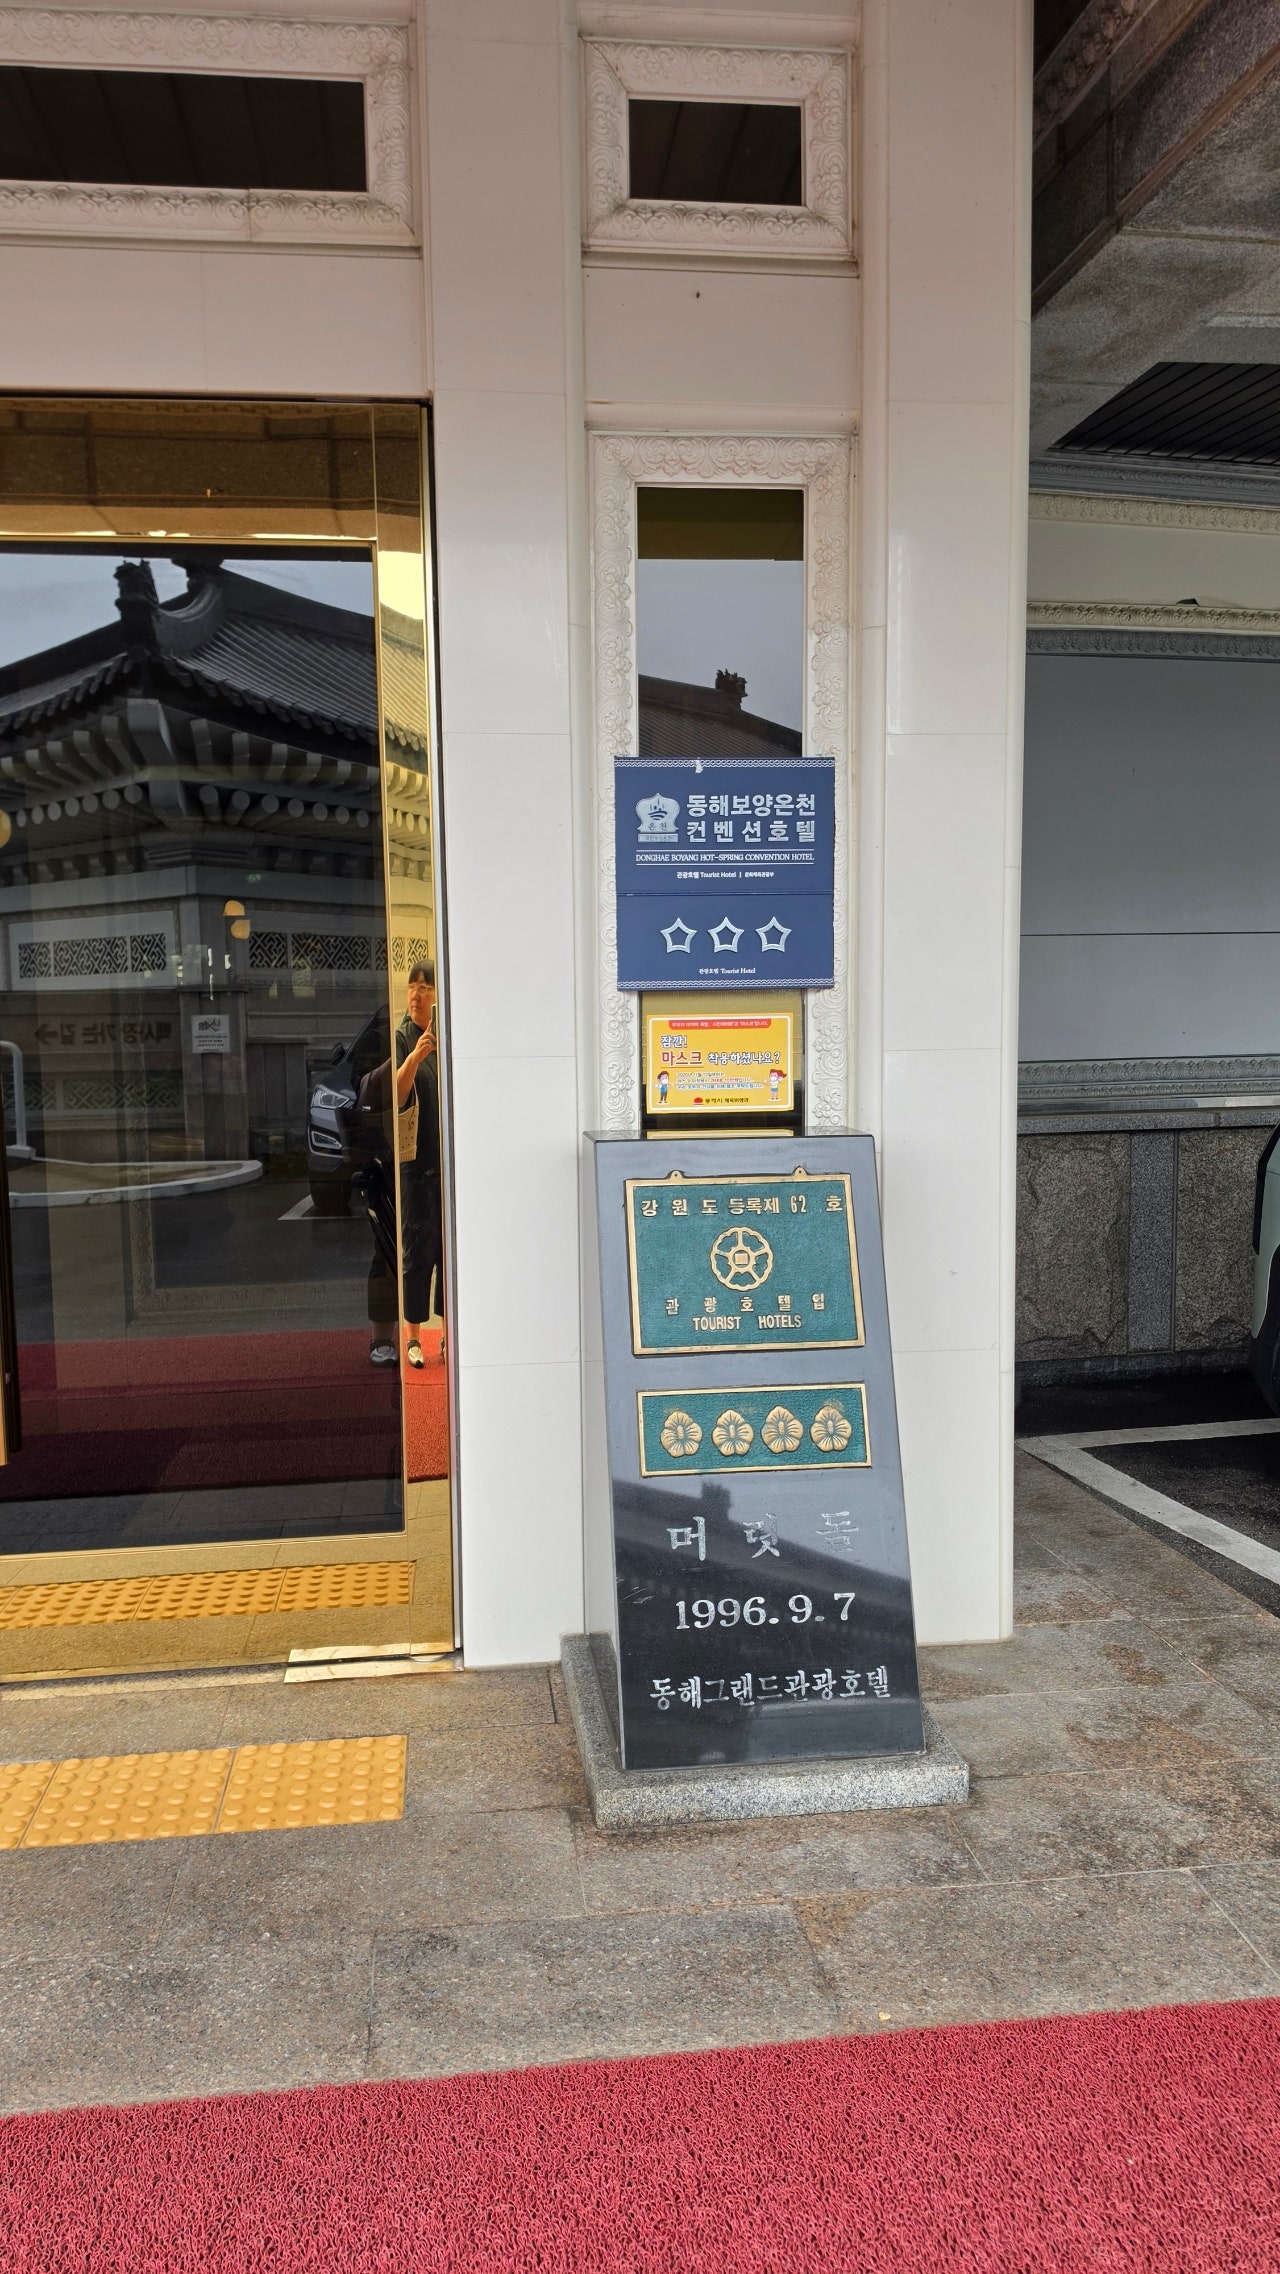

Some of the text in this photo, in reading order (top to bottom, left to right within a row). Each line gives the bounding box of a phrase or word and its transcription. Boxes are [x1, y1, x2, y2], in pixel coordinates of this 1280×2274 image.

[686, 793, 816, 817] 동해보양온천
[635, 852, 815, 862] DONGHAE BOYANG HOT-SPRING CONVENTION HOTEL
[660, 1034, 688, 1048] 잠깐!
[661, 1051, 781, 1066] 마스크 착용하셨나요?
[790, 1195, 807, 1213] 62
[826, 1195, 843, 1212] 호
[693, 1314, 802, 1331] TOURIST HOTELS
[649, 1665, 891, 1710] 동해그랜드관광호텔
